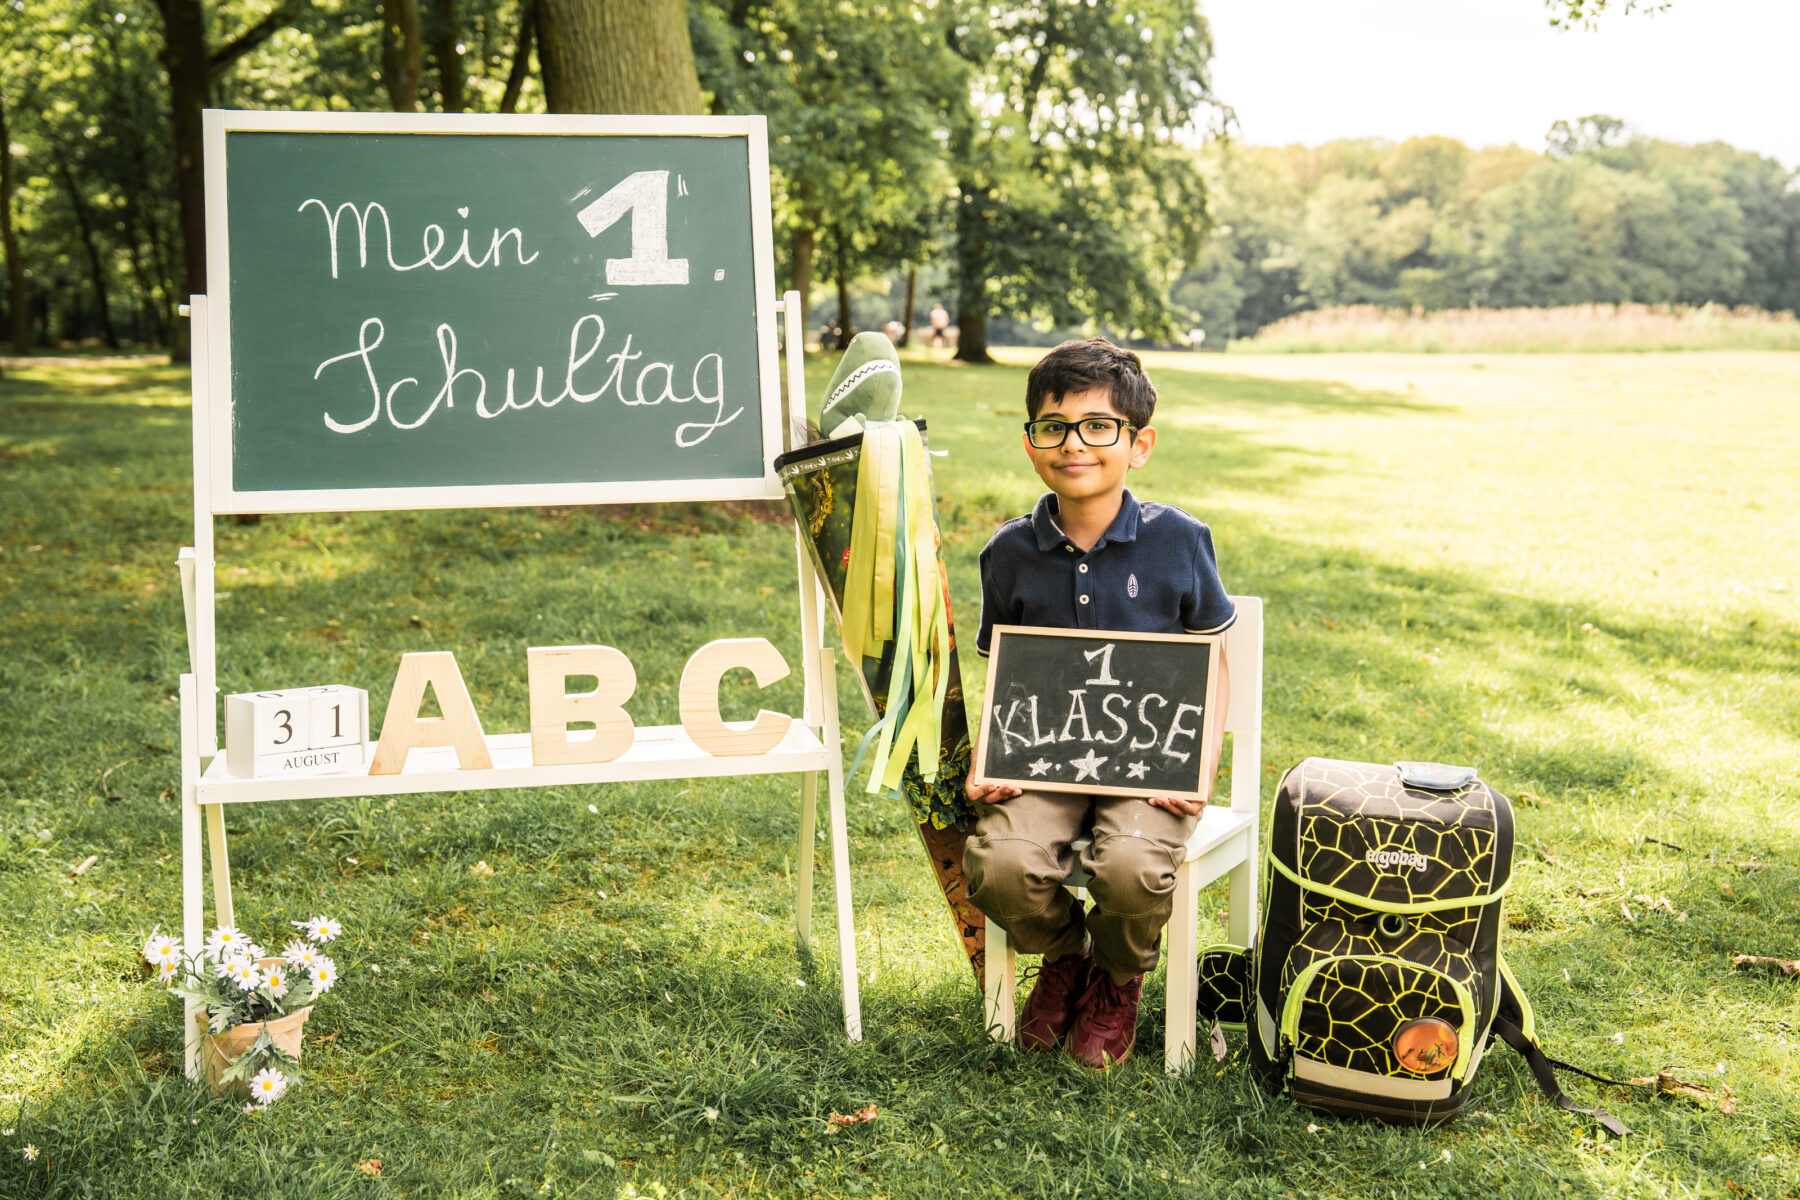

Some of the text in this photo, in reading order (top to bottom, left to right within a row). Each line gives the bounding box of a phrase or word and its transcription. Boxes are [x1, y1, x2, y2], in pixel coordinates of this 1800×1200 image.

[297, 198, 540, 280] Mein
[313, 314, 746, 448] Schultag
[1083, 643, 1134, 687] 1.
[993, 688, 1204, 764] KLASSE
[282, 752, 340, 770] AUGUST
[1365, 849, 1428, 873] ergobag
